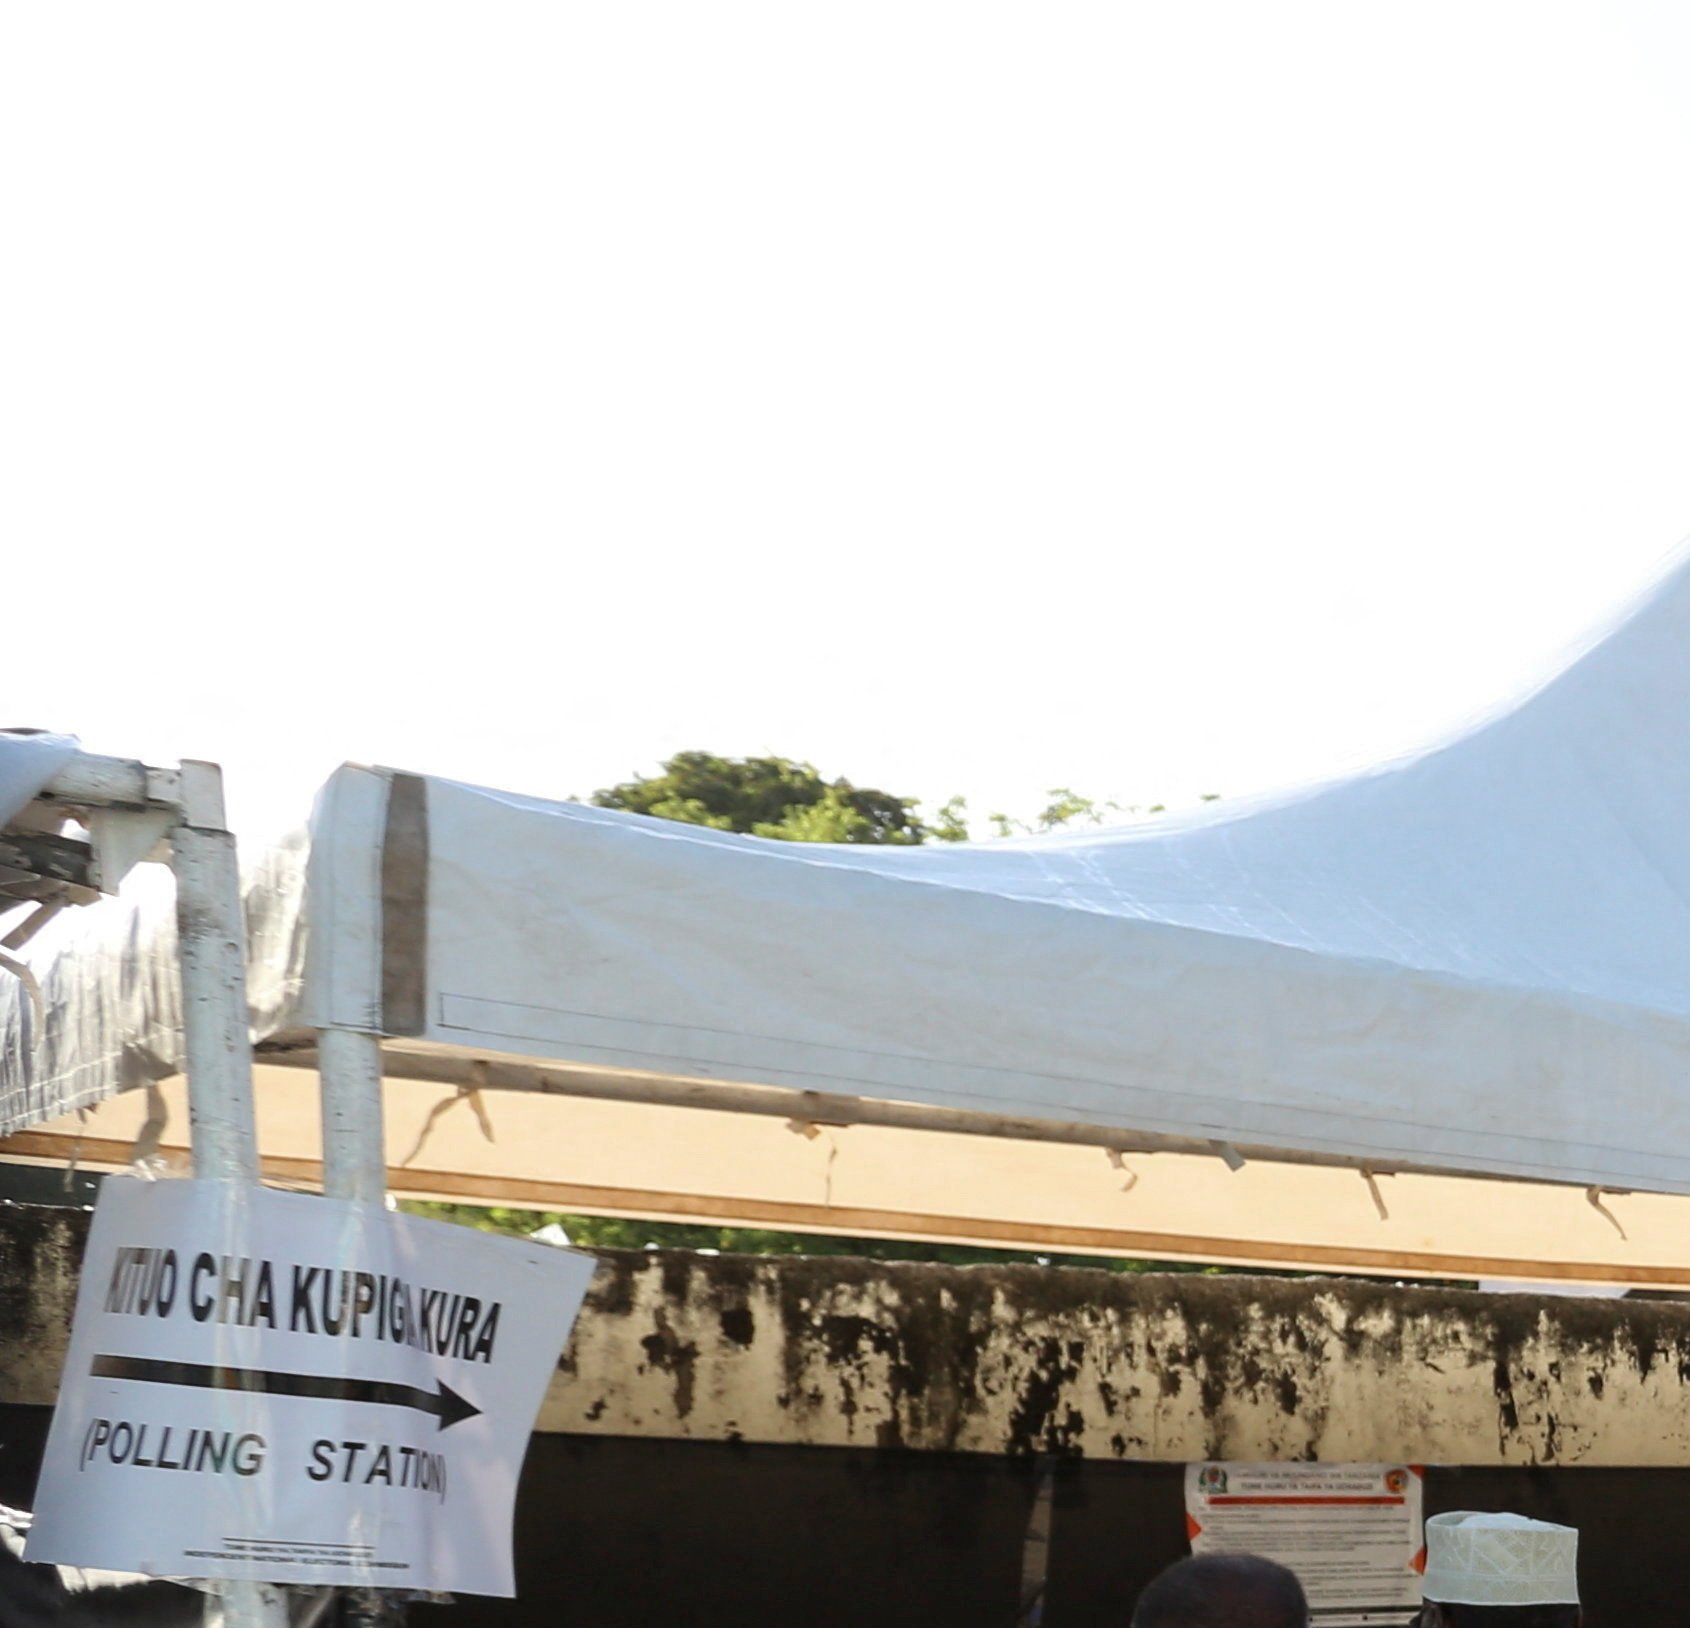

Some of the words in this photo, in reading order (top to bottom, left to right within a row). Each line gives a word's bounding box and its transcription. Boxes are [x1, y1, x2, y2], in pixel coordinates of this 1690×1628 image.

[104, 1247, 177, 1318] KITUO
[190, 1252, 278, 1330] CHA
[420, 1287, 502, 1364] KURA
[80, 1415, 267, 1477] (POLLING
